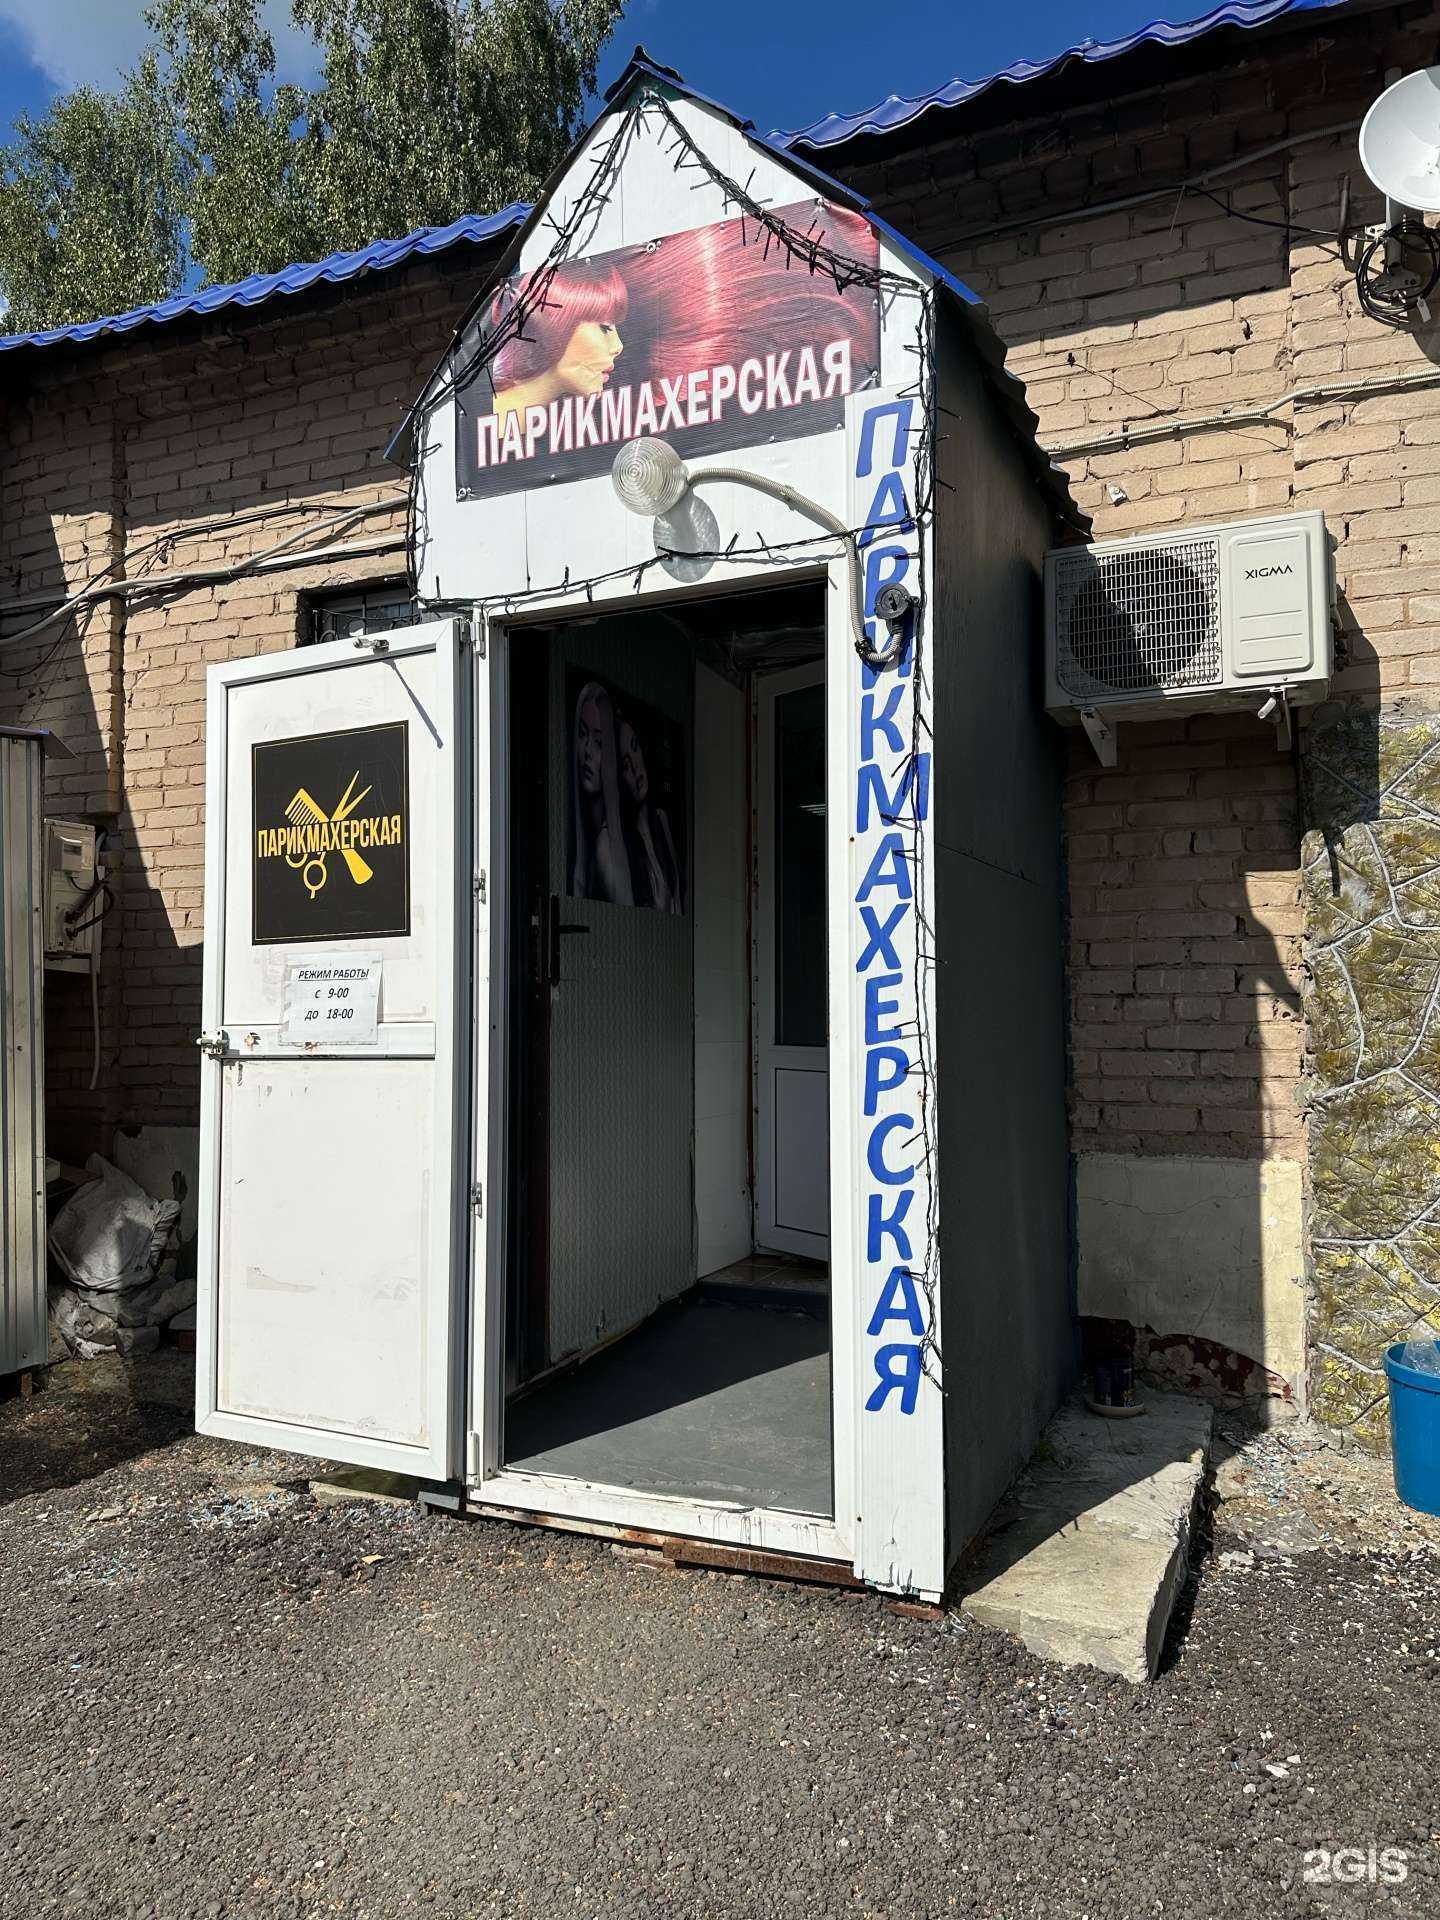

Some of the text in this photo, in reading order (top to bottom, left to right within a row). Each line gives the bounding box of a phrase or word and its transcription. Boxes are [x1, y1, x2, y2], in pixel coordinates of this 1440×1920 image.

[476, 338, 853, 468] ПАРИКМАХЕРСКАЯ
[1244, 564, 1293, 580] XIGMA
[257, 815, 401, 858] ПАРИКМАХЕРСКАЯ
[298, 968, 370, 980] РЕЖИМ РАБОТЫ
[327, 987, 350, 999] 9-00
[326, 1008, 354, 1020] 18-00
